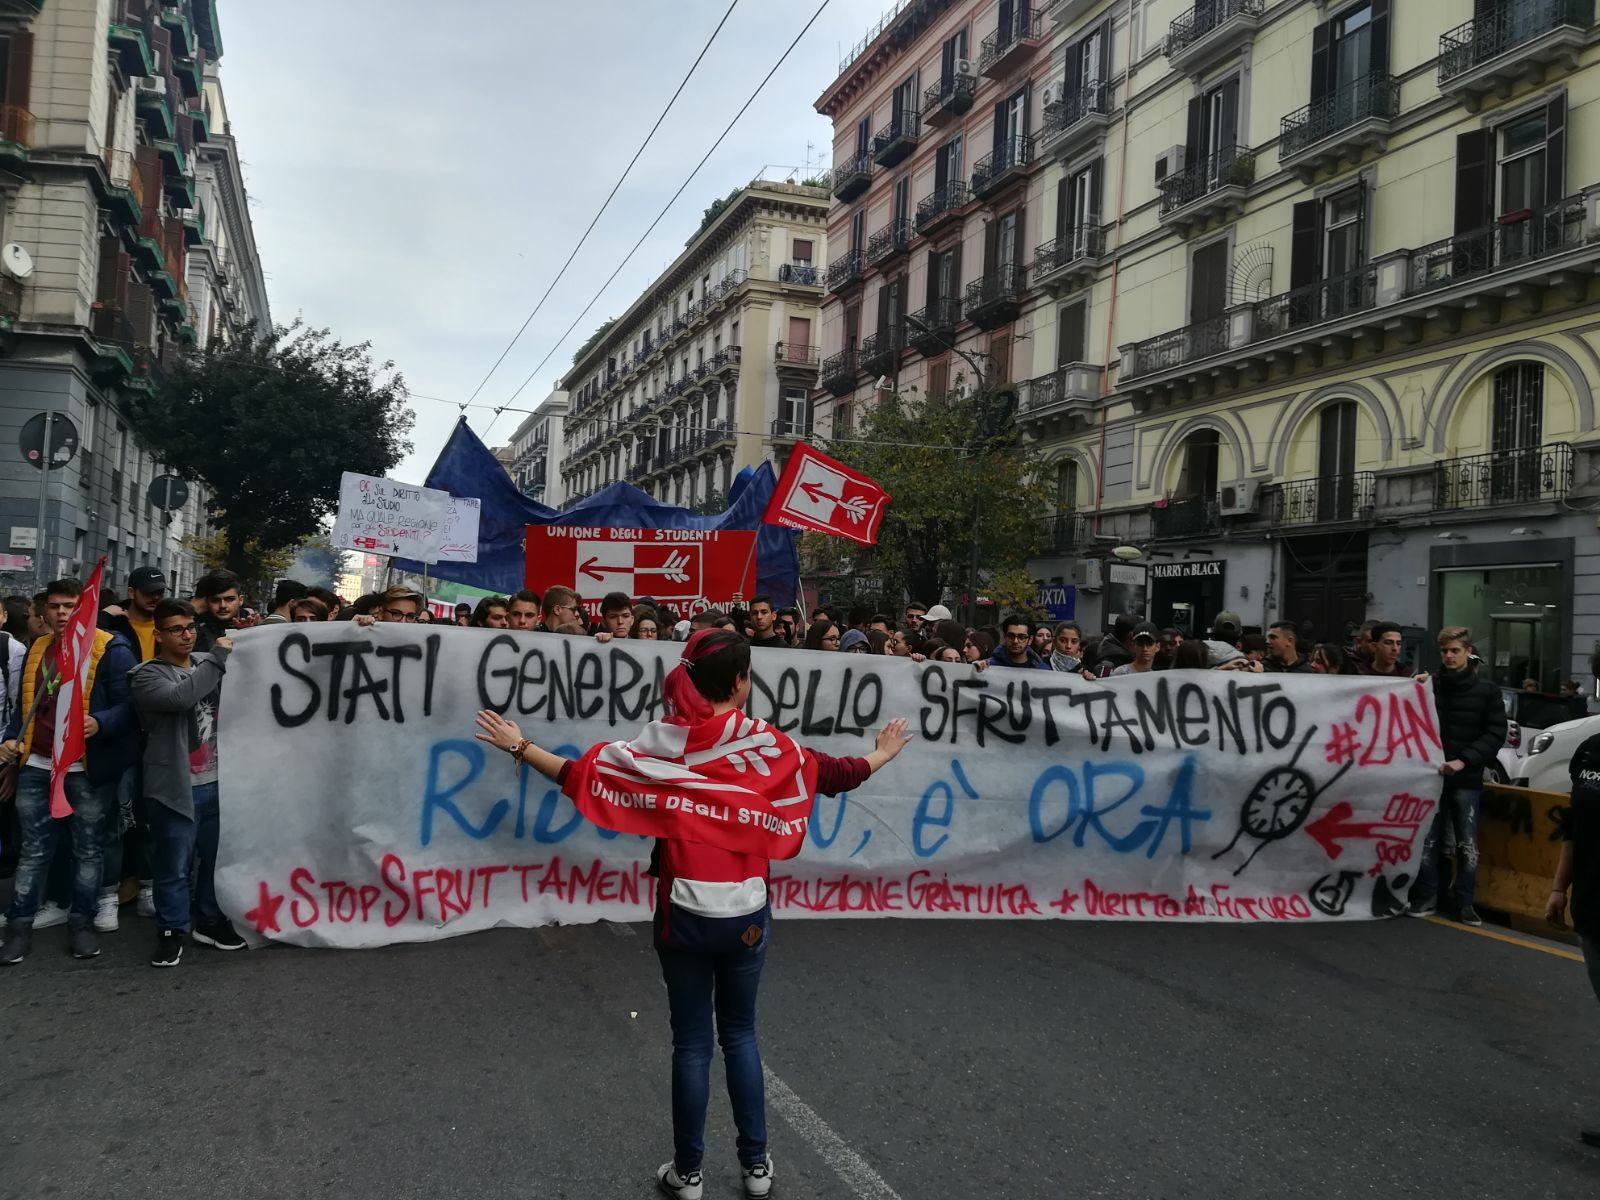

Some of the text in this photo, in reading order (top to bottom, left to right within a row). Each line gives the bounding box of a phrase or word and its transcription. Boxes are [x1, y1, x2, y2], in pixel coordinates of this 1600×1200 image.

[546, 525, 719, 542] UNIONE DEGLI STUDENTI
[1153, 564, 1183, 578] MARRY
[1190, 561, 1221, 576] BLACK
[270, 632, 441, 728] STATI
[591, 779, 809, 837] UNIONE DEGLI STUDENTI
[1028, 755, 1212, 859] ORA
